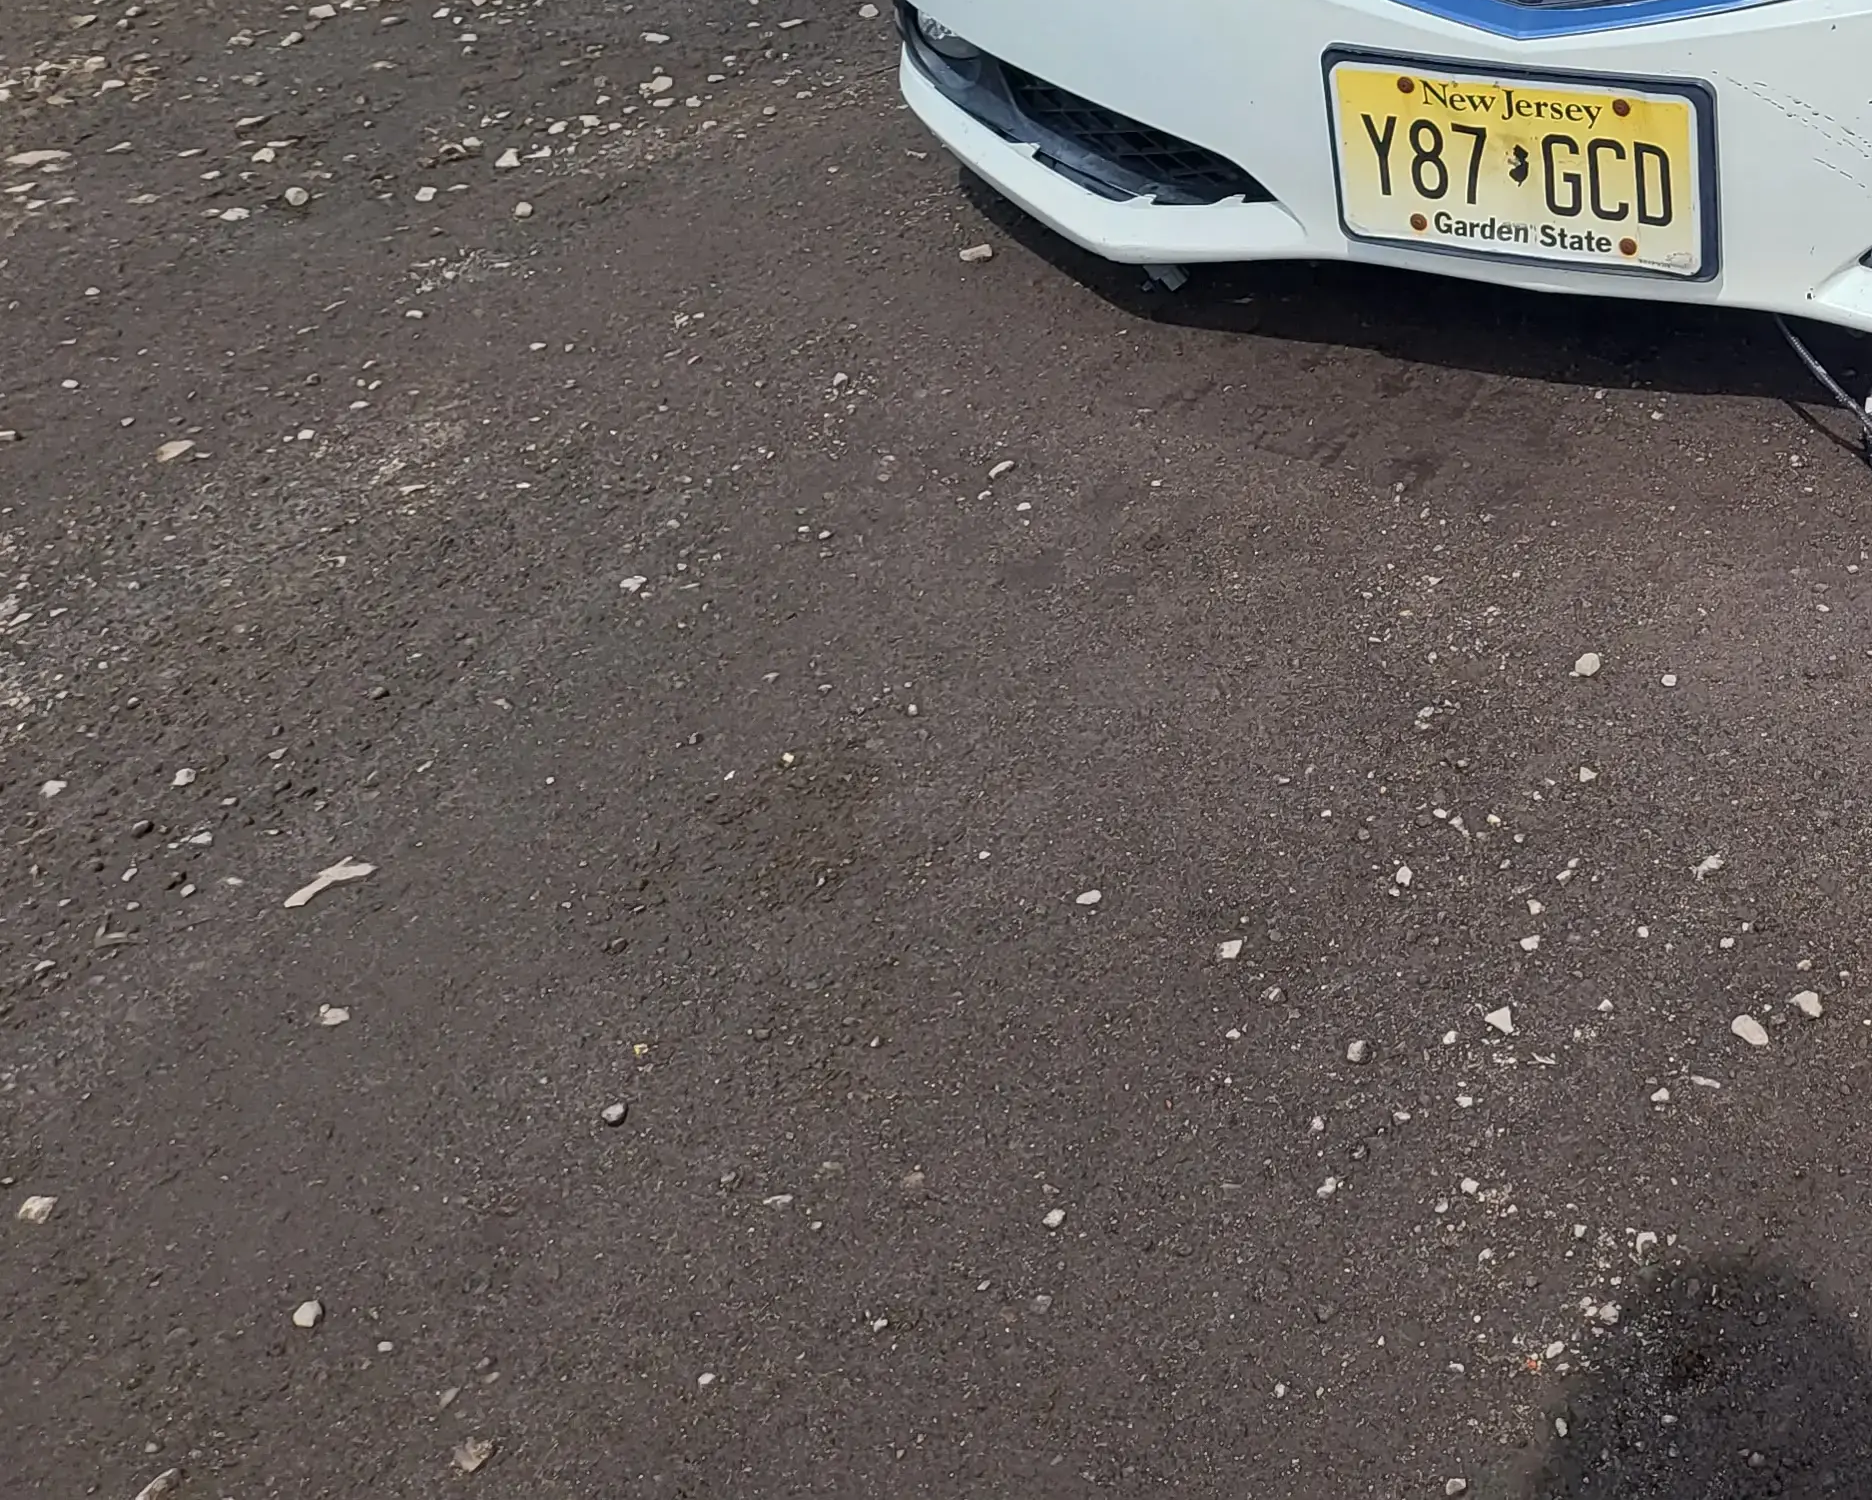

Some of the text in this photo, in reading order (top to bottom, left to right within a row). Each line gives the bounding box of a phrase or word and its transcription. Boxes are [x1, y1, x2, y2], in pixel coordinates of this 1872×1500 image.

[1420, 79, 1603, 129] New Jersey
[1360, 112, 1673, 227] Y87 GCD
[1433, 211, 1613, 254] Garden State
